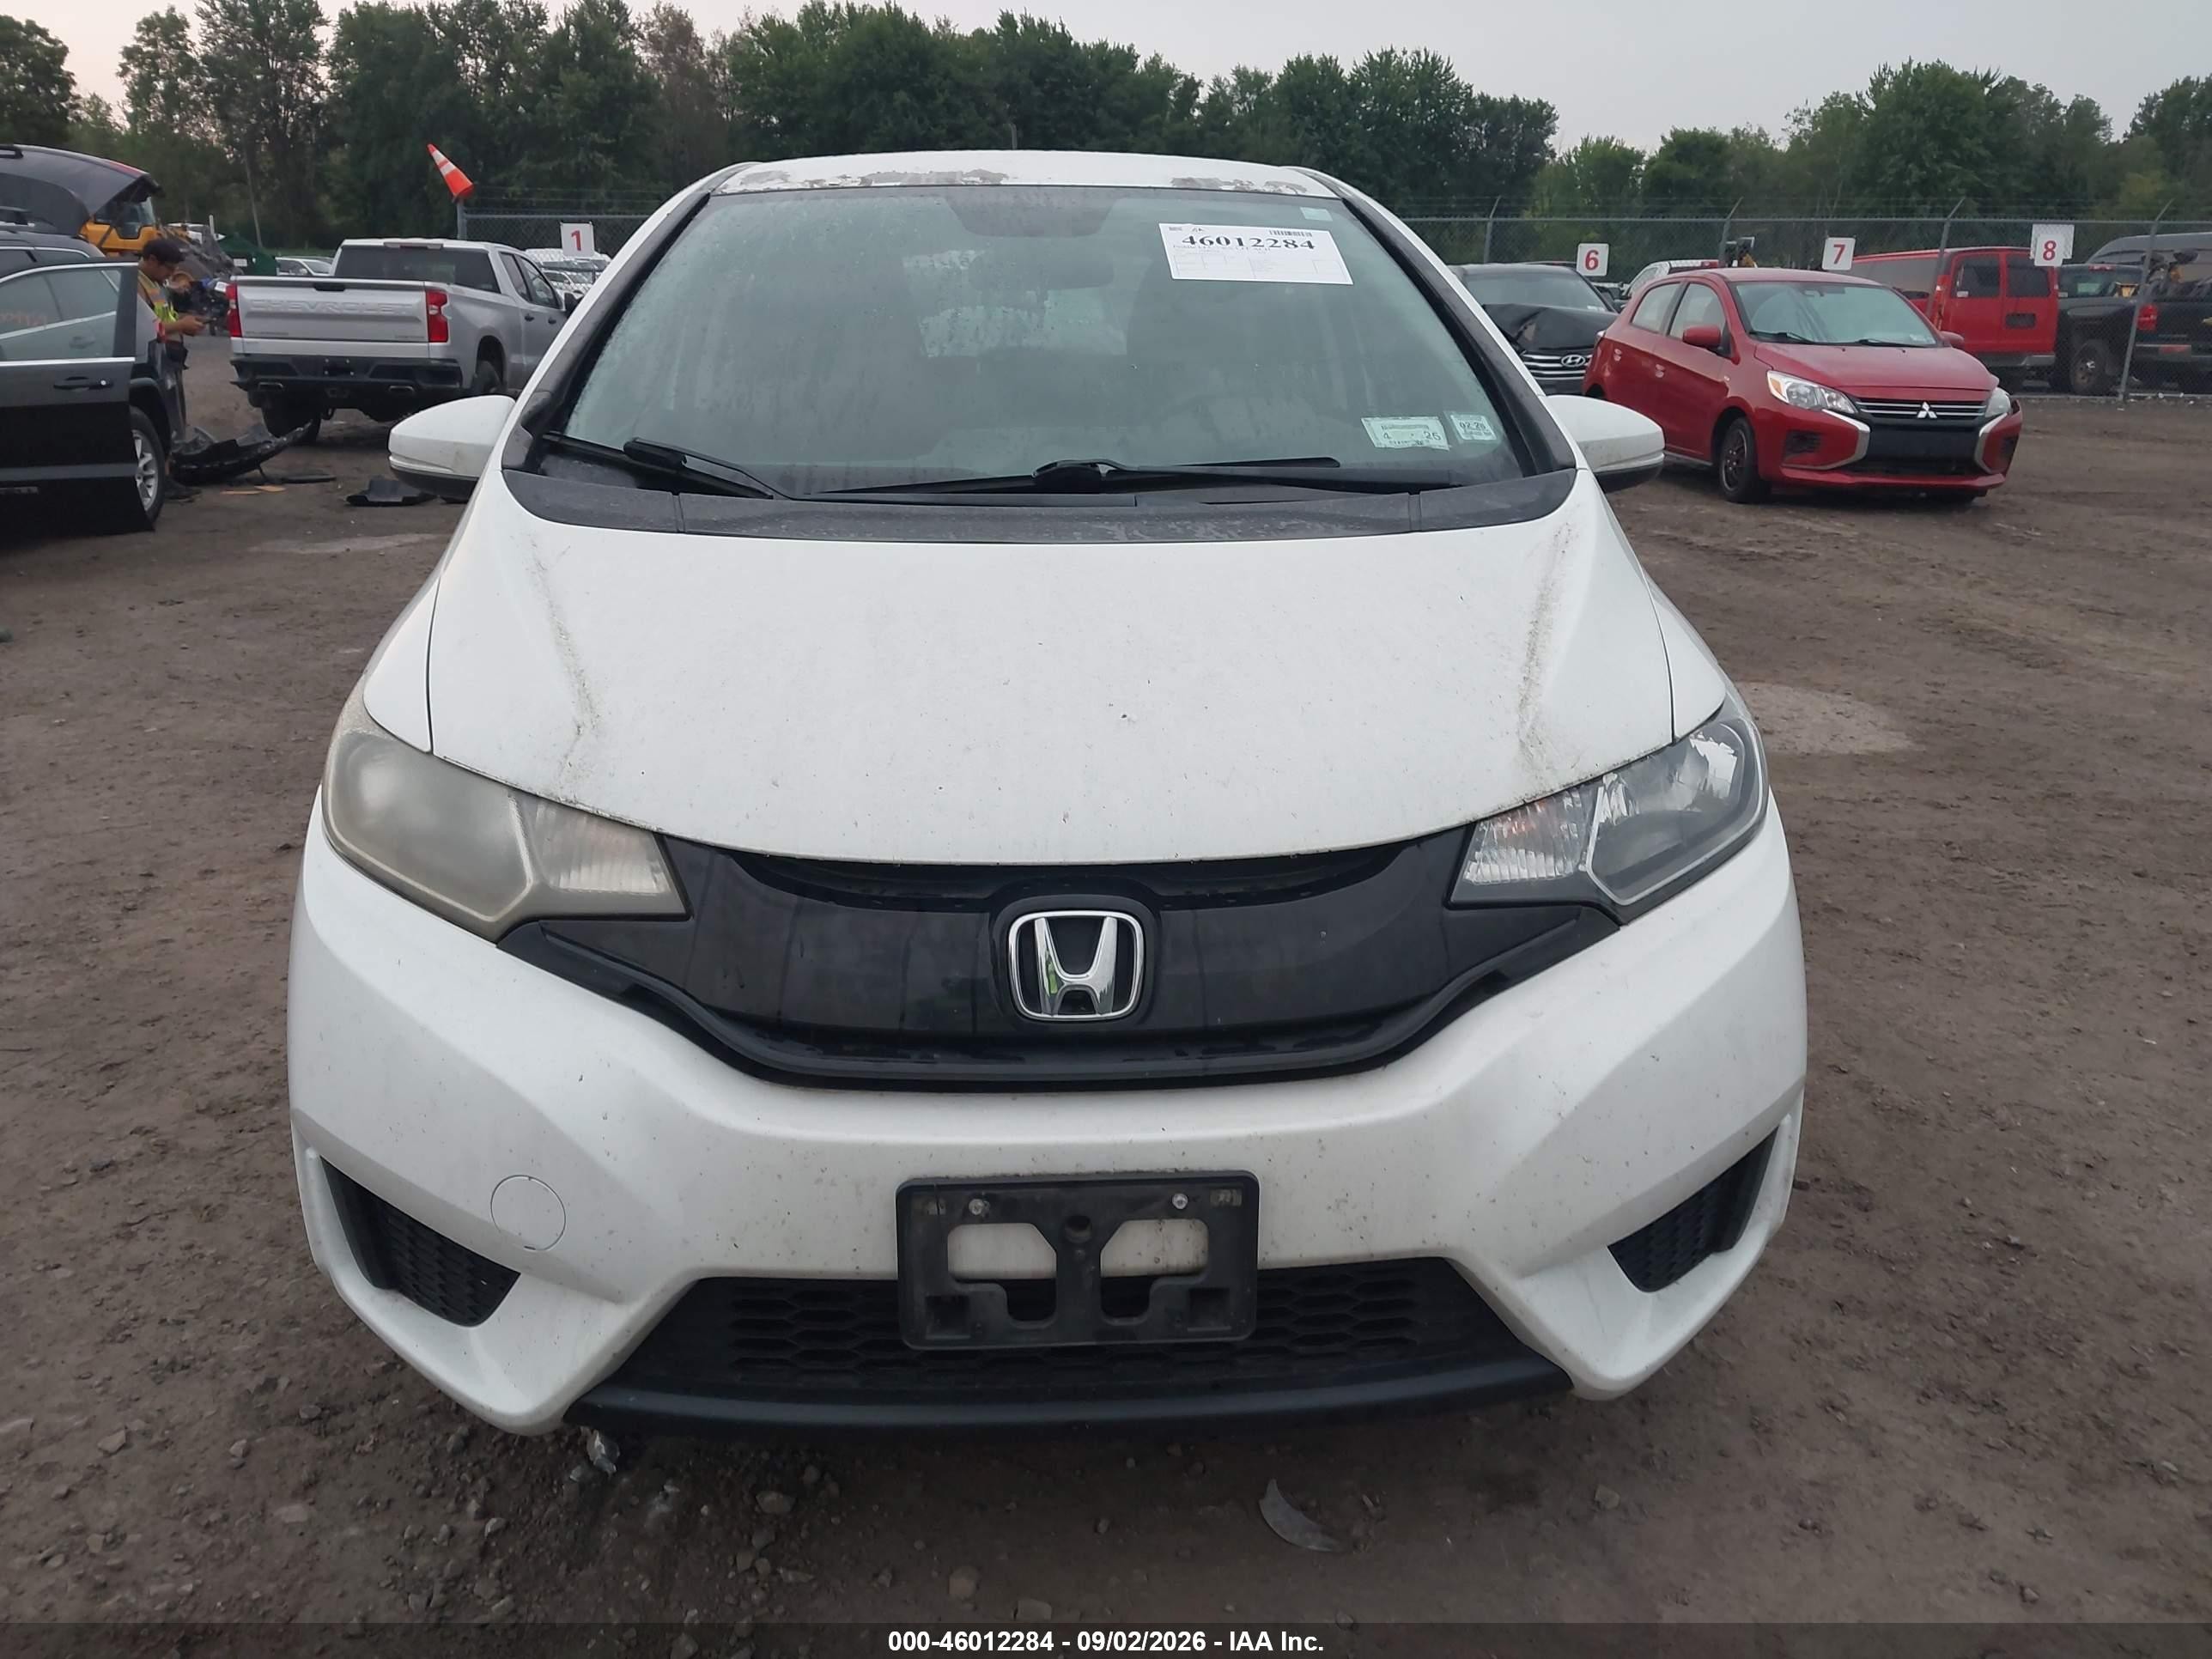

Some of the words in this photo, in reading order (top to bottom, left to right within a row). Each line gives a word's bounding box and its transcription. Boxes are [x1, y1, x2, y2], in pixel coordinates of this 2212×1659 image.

[570, 229, 582, 252] 1
[1182, 235, 1316, 250] 46012284
[2043, 240, 2057, 261] 8
[1585, 249, 1599, 270] 6
[1833, 244, 1846, 264] 7
[249, 298, 414, 315] CHEVROLET
